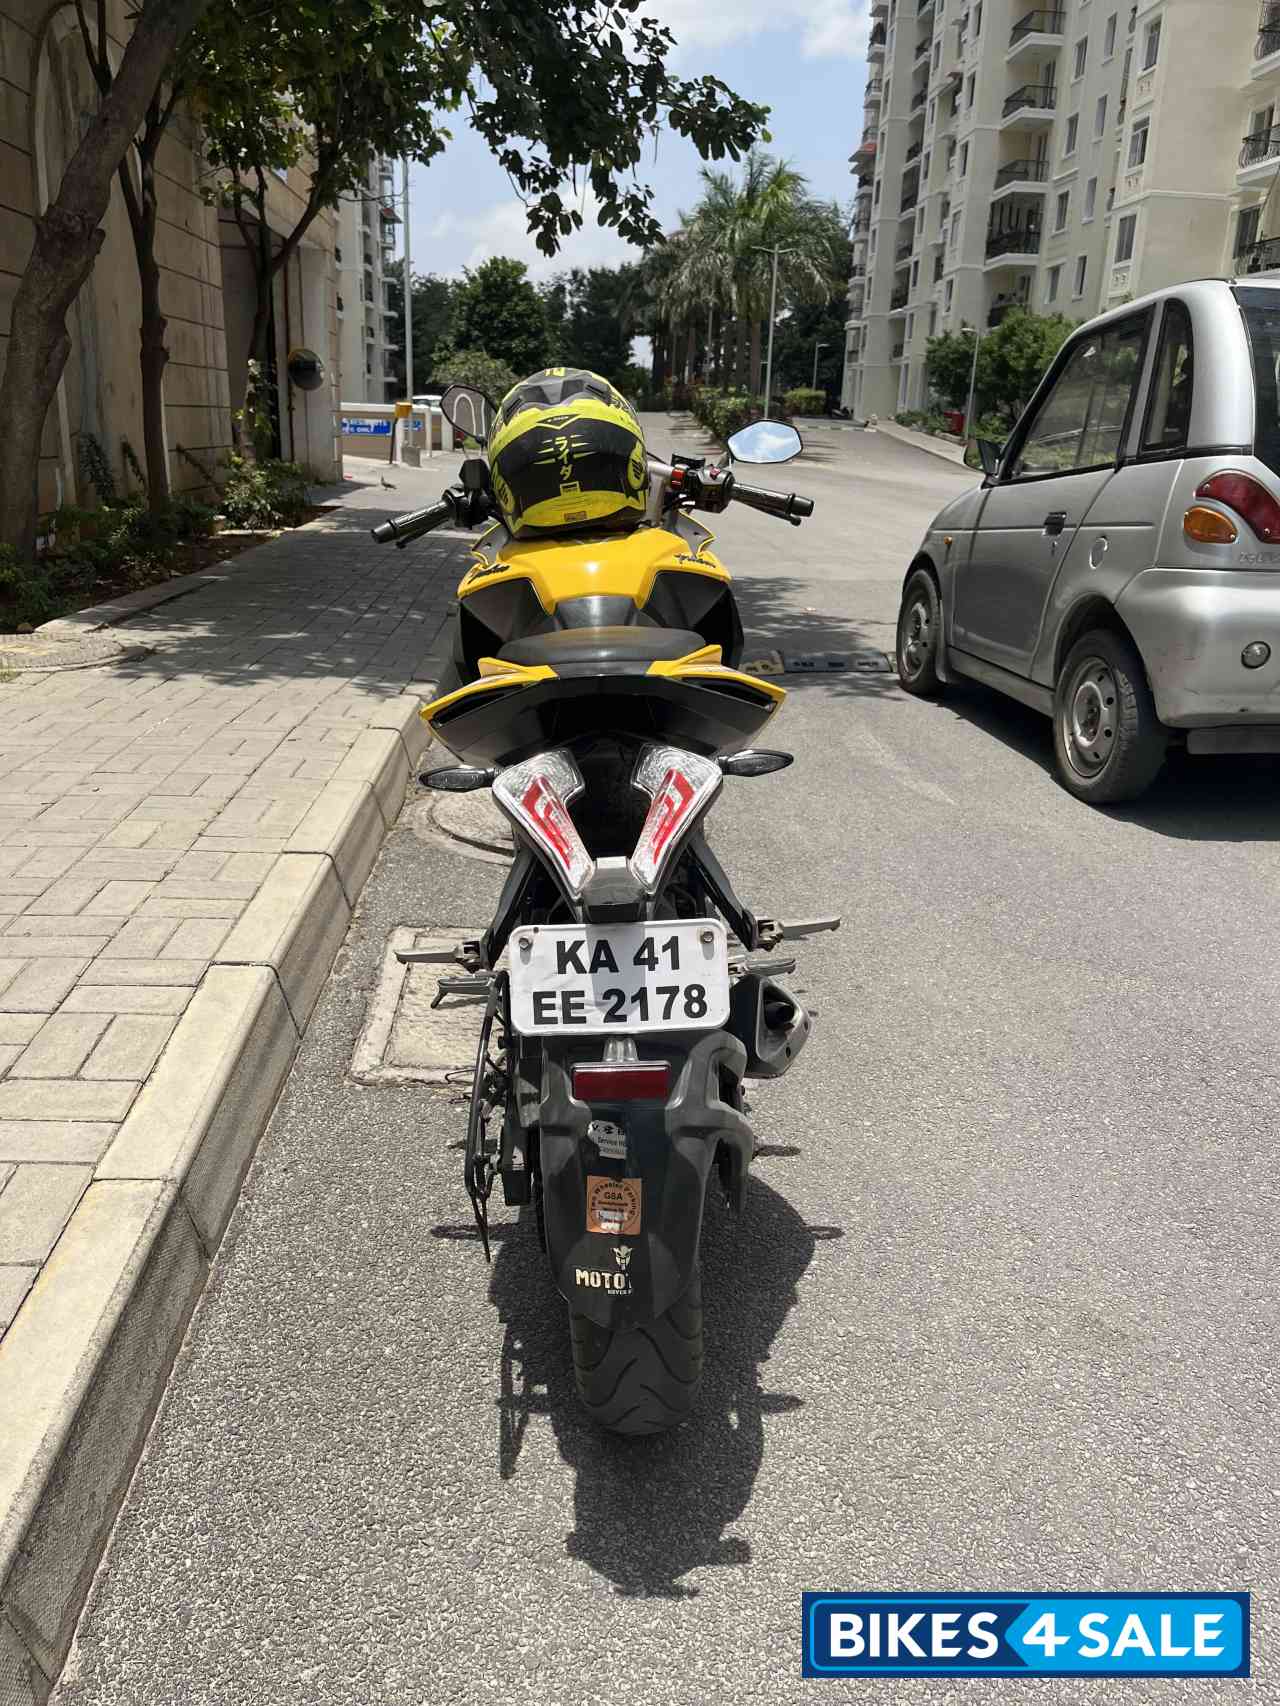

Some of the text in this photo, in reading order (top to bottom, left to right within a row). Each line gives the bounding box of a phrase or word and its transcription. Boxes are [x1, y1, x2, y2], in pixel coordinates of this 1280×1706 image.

[556, 935, 681, 975] KA 41
[532, 983, 708, 1025] EE 2178
[575, 1268, 632, 1290] MOTO
